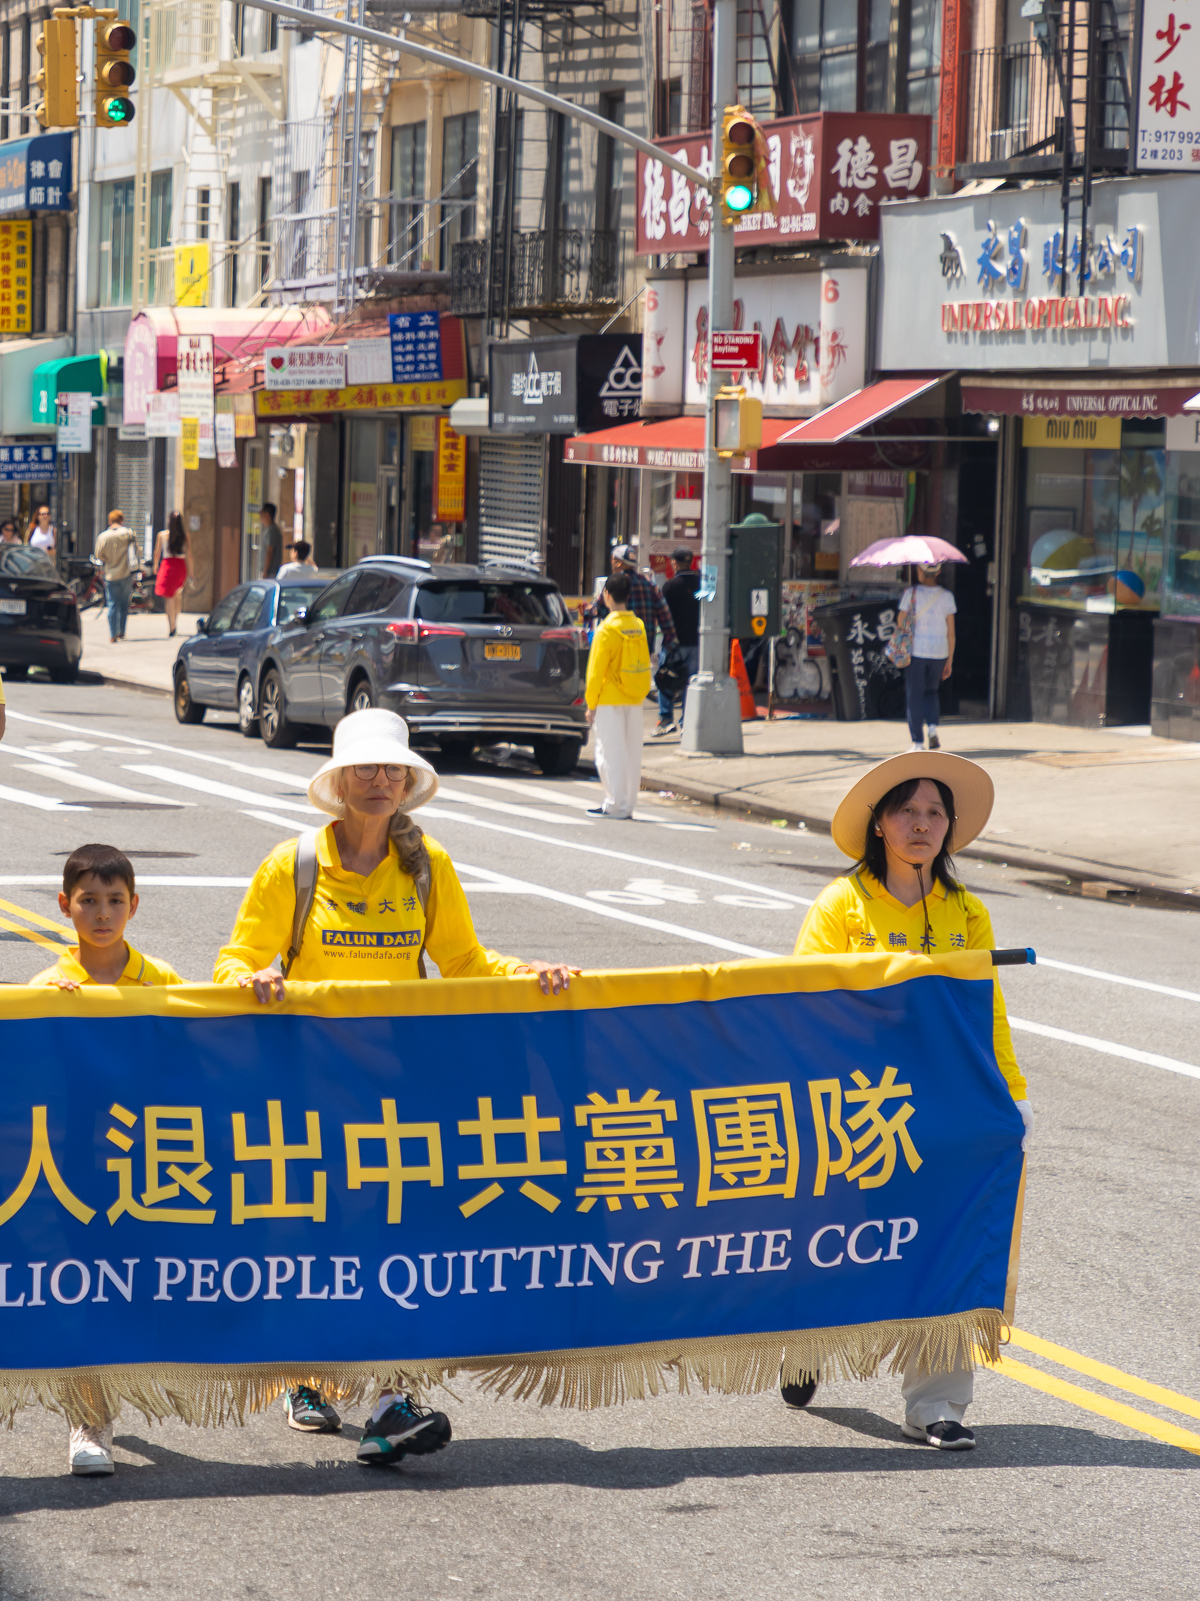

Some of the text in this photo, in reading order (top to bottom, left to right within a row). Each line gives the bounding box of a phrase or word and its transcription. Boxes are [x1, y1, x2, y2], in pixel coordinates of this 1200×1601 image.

[1149, 13, 1192, 118] 少林
[831, 135, 923, 190] 德昌
[824, 279, 839, 304] 6
[941, 299, 1024, 332] UNIVERSAL
[1025, 297, 1092, 329] OPTICAL
[713, 336, 754, 344] NO STANDING
[713, 345, 739, 353] Anytime
[1066, 395, 1106, 411] UNIVERSAL
[1108, 396, 1141, 411] OPTICAL
[655, 451, 672, 466] MEAT
[672, 452, 698, 467] MARKET
[326, 932, 420, 946] FALUN DAFA
[860, 931, 966, 948] 法輪大法
[323, 950, 411, 961] www.falundafa.org
[155, 1255, 365, 1303] PEOPLE
[378, 1239, 666, 1310] QUITTING
[677, 1228, 793, 1275] THE
[806, 1217, 920, 1271] CCP
